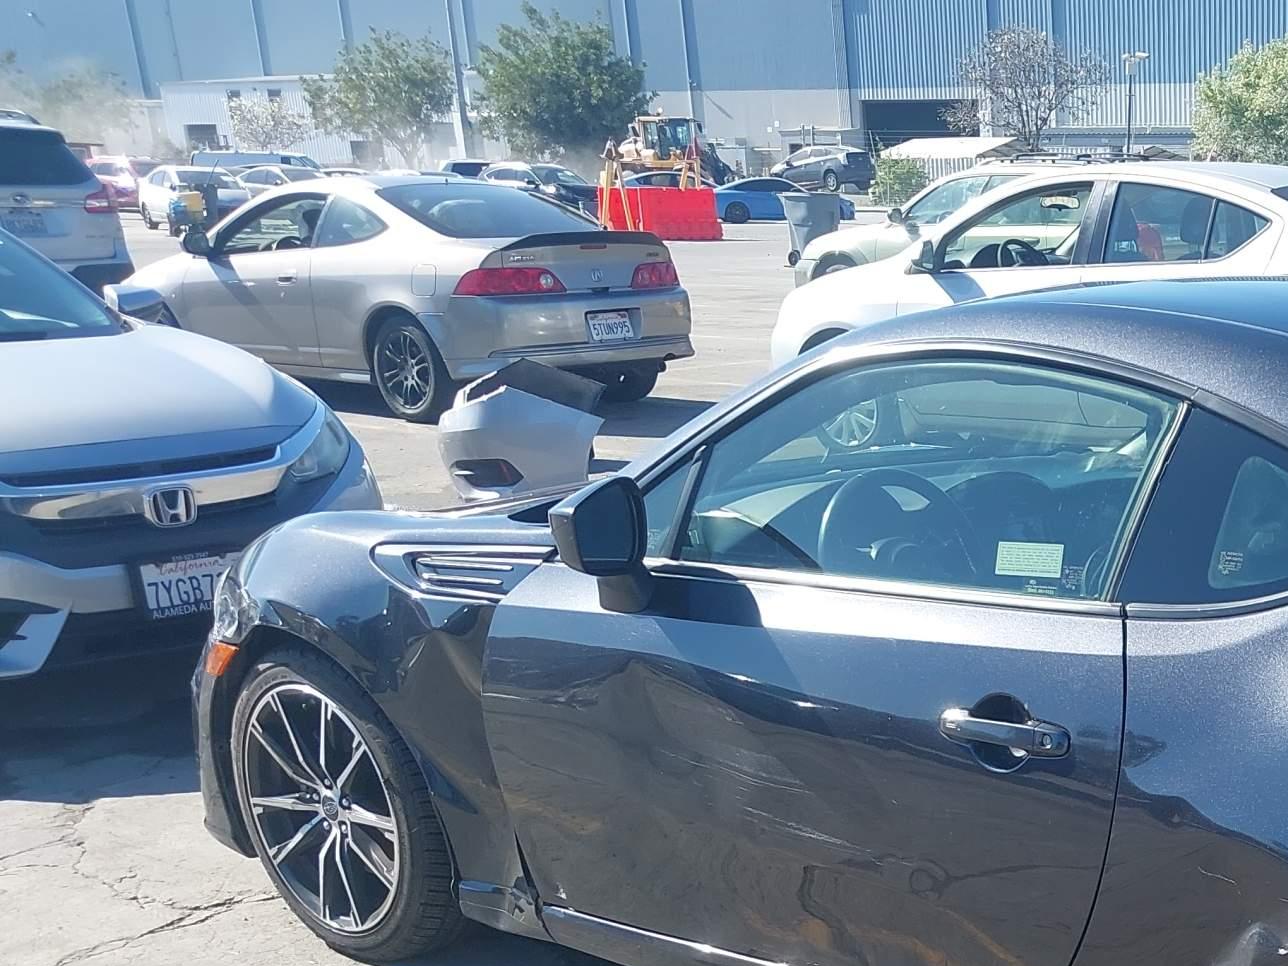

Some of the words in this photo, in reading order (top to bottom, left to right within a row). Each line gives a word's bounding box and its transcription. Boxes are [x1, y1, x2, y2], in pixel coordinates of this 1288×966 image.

[592, 320, 630, 336] 5TUN995
[160, 558, 220, 577] California
[147, 572, 224, 611] 7YGB7
[153, 603, 198, 620] ALAMEDA
[200, 599, 215, 611] AU
